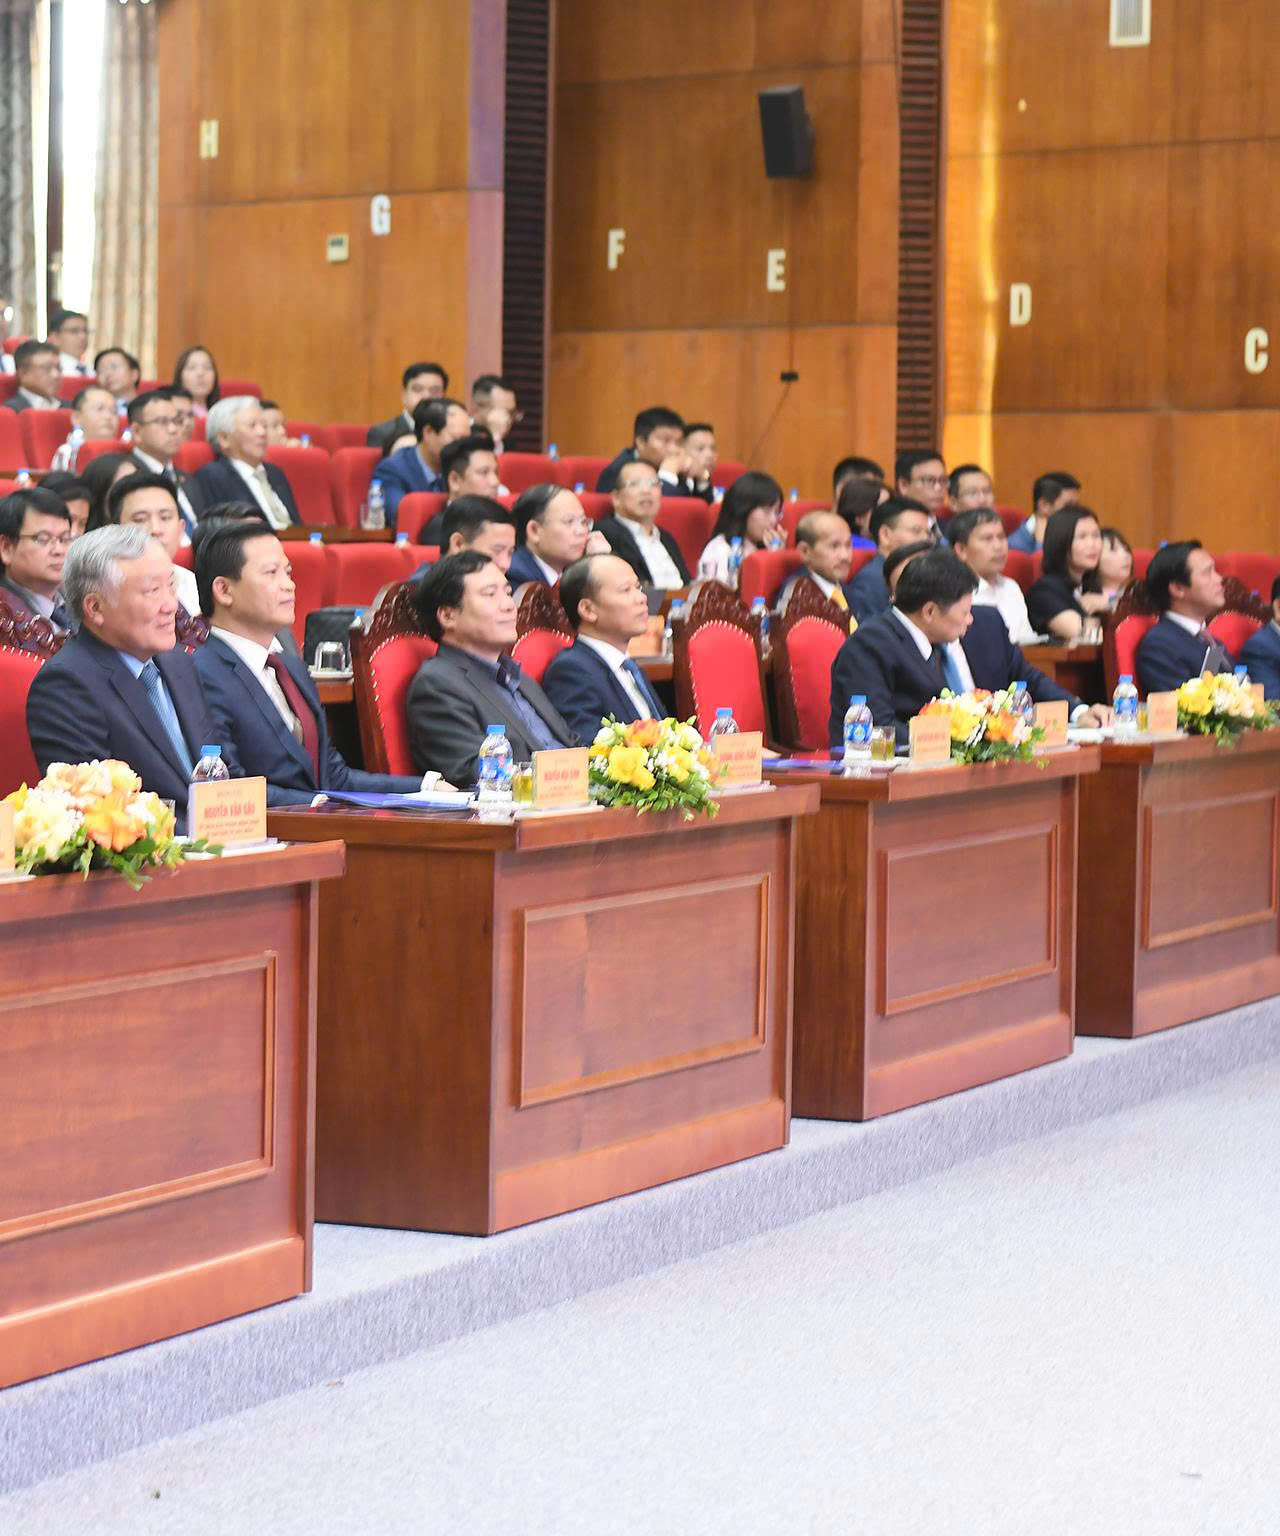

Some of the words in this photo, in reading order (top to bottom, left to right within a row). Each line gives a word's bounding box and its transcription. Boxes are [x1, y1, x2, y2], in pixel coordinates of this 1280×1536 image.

[200, 119, 219, 159] H
[370, 194, 391, 236] G
[608, 229, 626, 271] F
[767, 249, 786, 292] E
[1010, 283, 1032, 326] D
[1245, 327, 1269, 374] C
